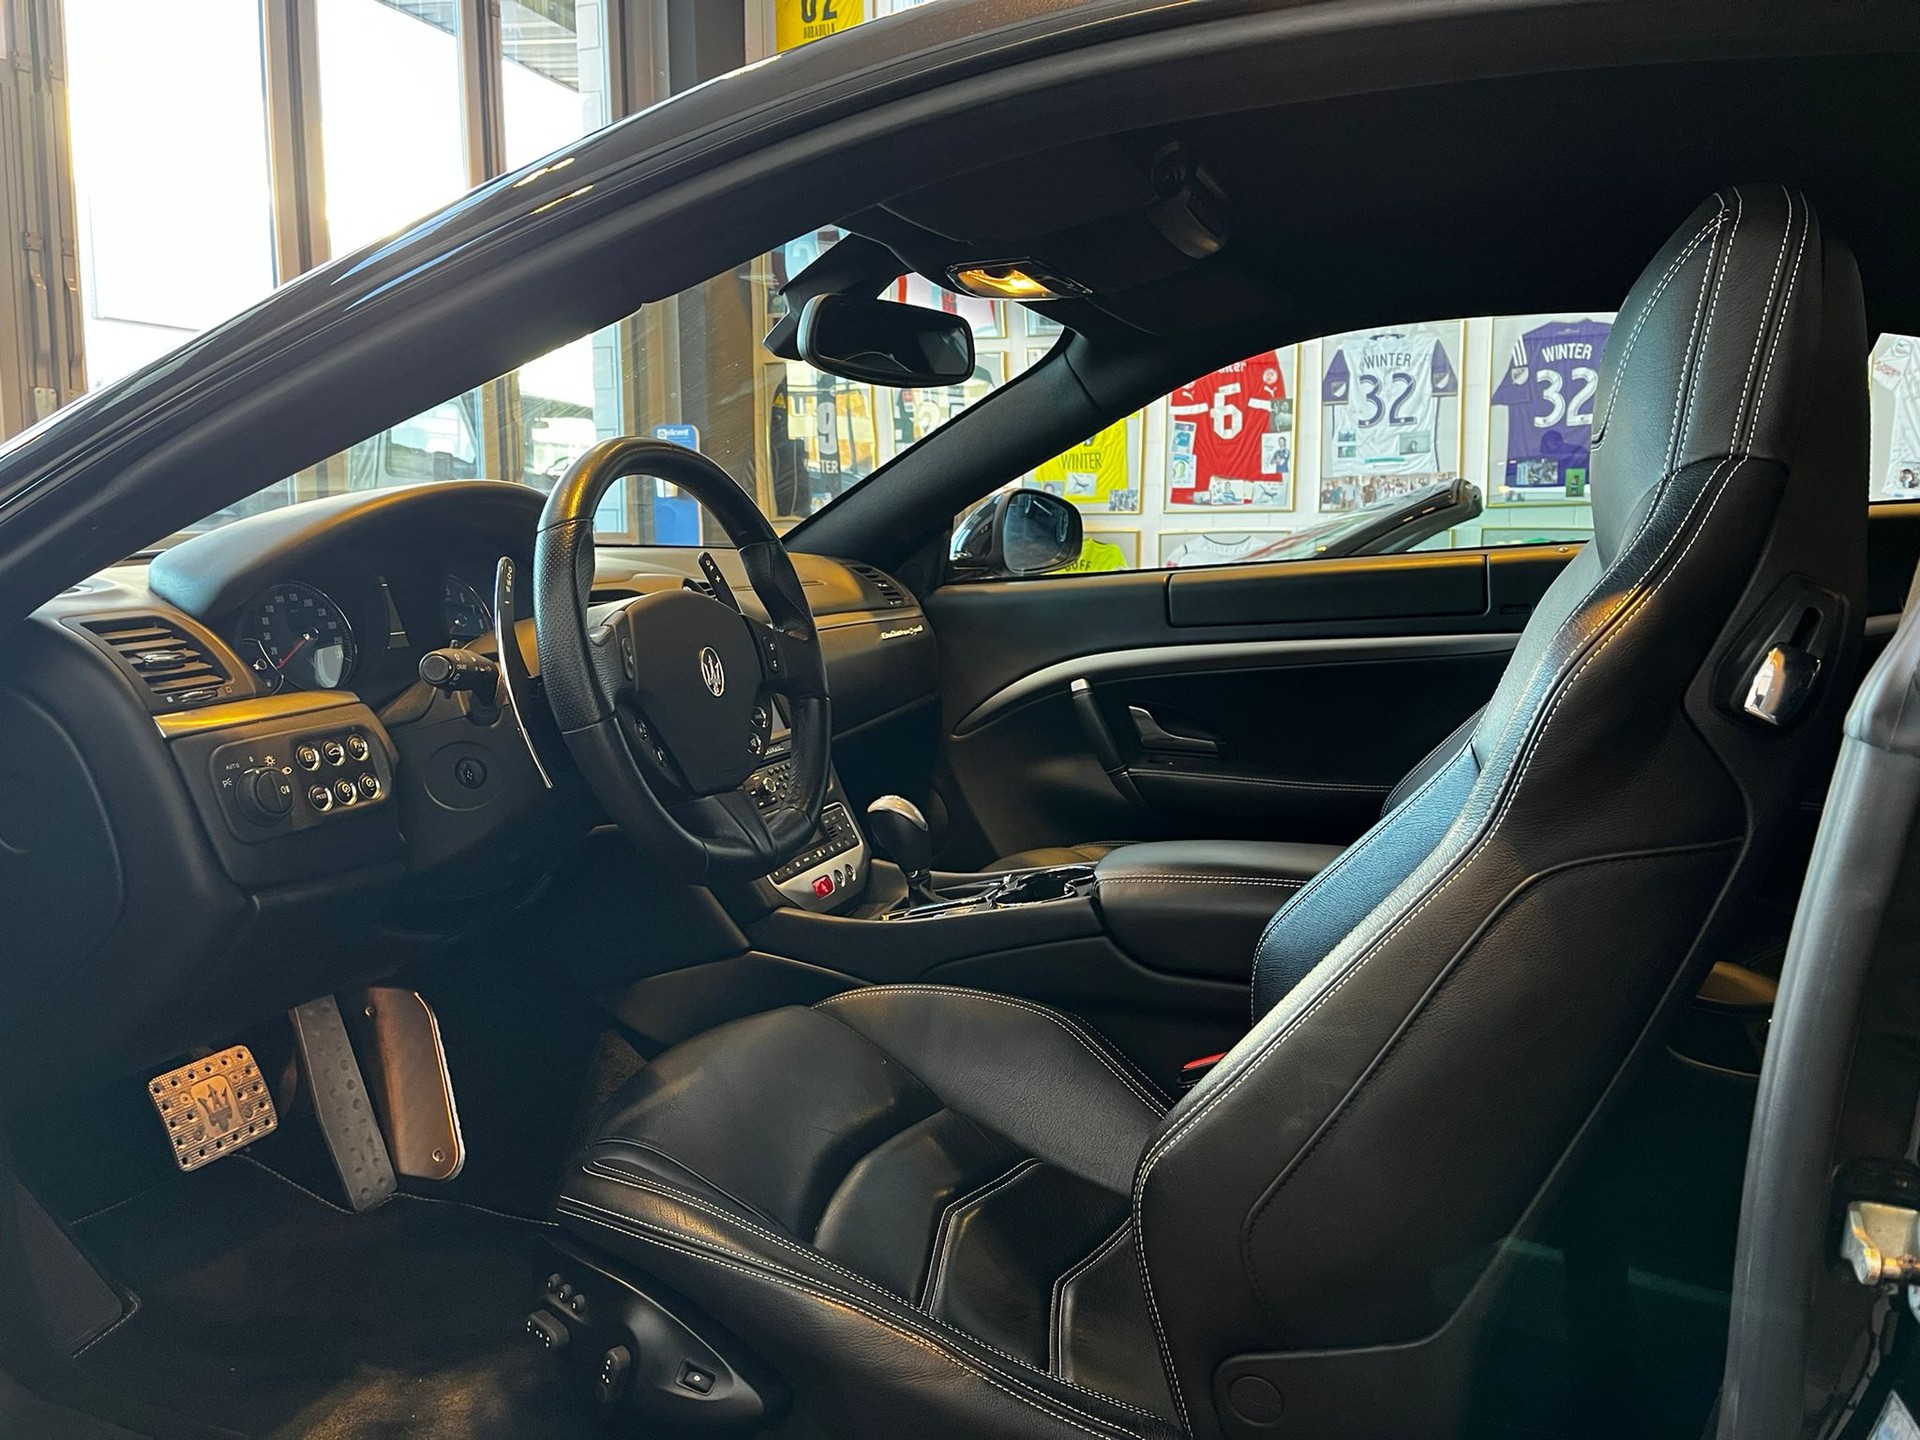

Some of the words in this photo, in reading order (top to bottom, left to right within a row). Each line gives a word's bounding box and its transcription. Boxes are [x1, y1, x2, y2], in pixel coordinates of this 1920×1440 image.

[1363, 352, 1412, 369] WINTER
[1542, 343, 1593, 363] WINTER
[1210, 382, 1243, 440] 6
[1358, 372, 1418, 428] 32
[1534, 367, 1599, 428] 32
[817, 401, 838, 455] 9
[1060, 451, 1102, 470] WINTER
